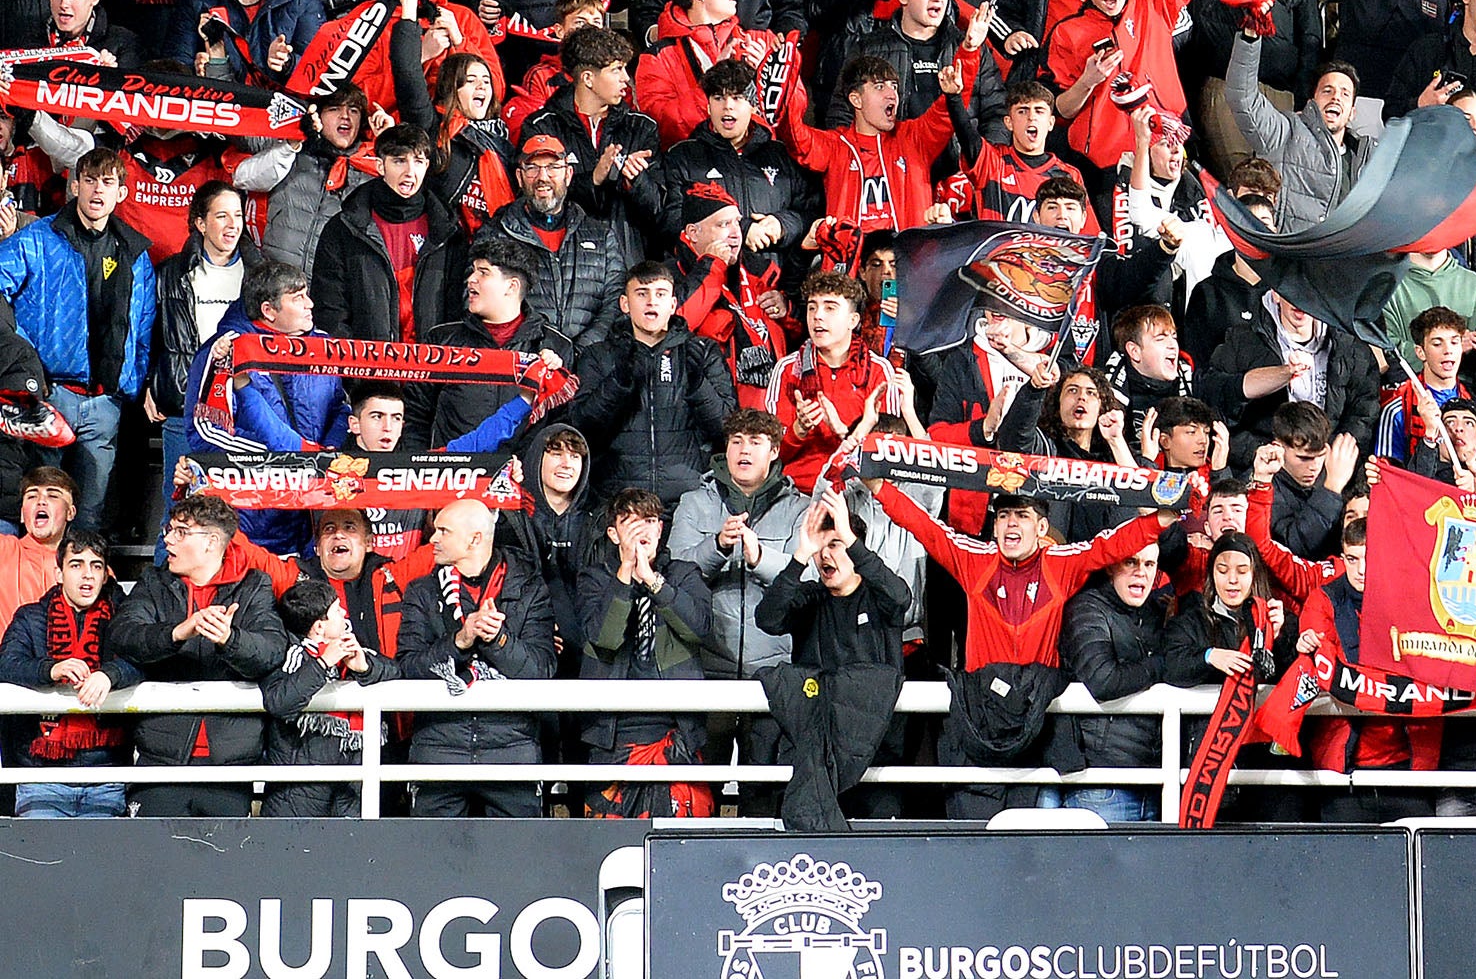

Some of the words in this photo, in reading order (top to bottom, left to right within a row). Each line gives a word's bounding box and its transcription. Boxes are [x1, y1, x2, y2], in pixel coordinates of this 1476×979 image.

[48, 65, 100, 87] Club
[121, 73, 236, 103] Deportivo
[136, 180, 195, 195] MIRANDA
[328, 336, 485, 367] MIRANDES
[208, 468, 314, 493] JABATOS
[1037, 457, 1148, 491] JABATOS
[774, 915, 831, 937] CLUB
